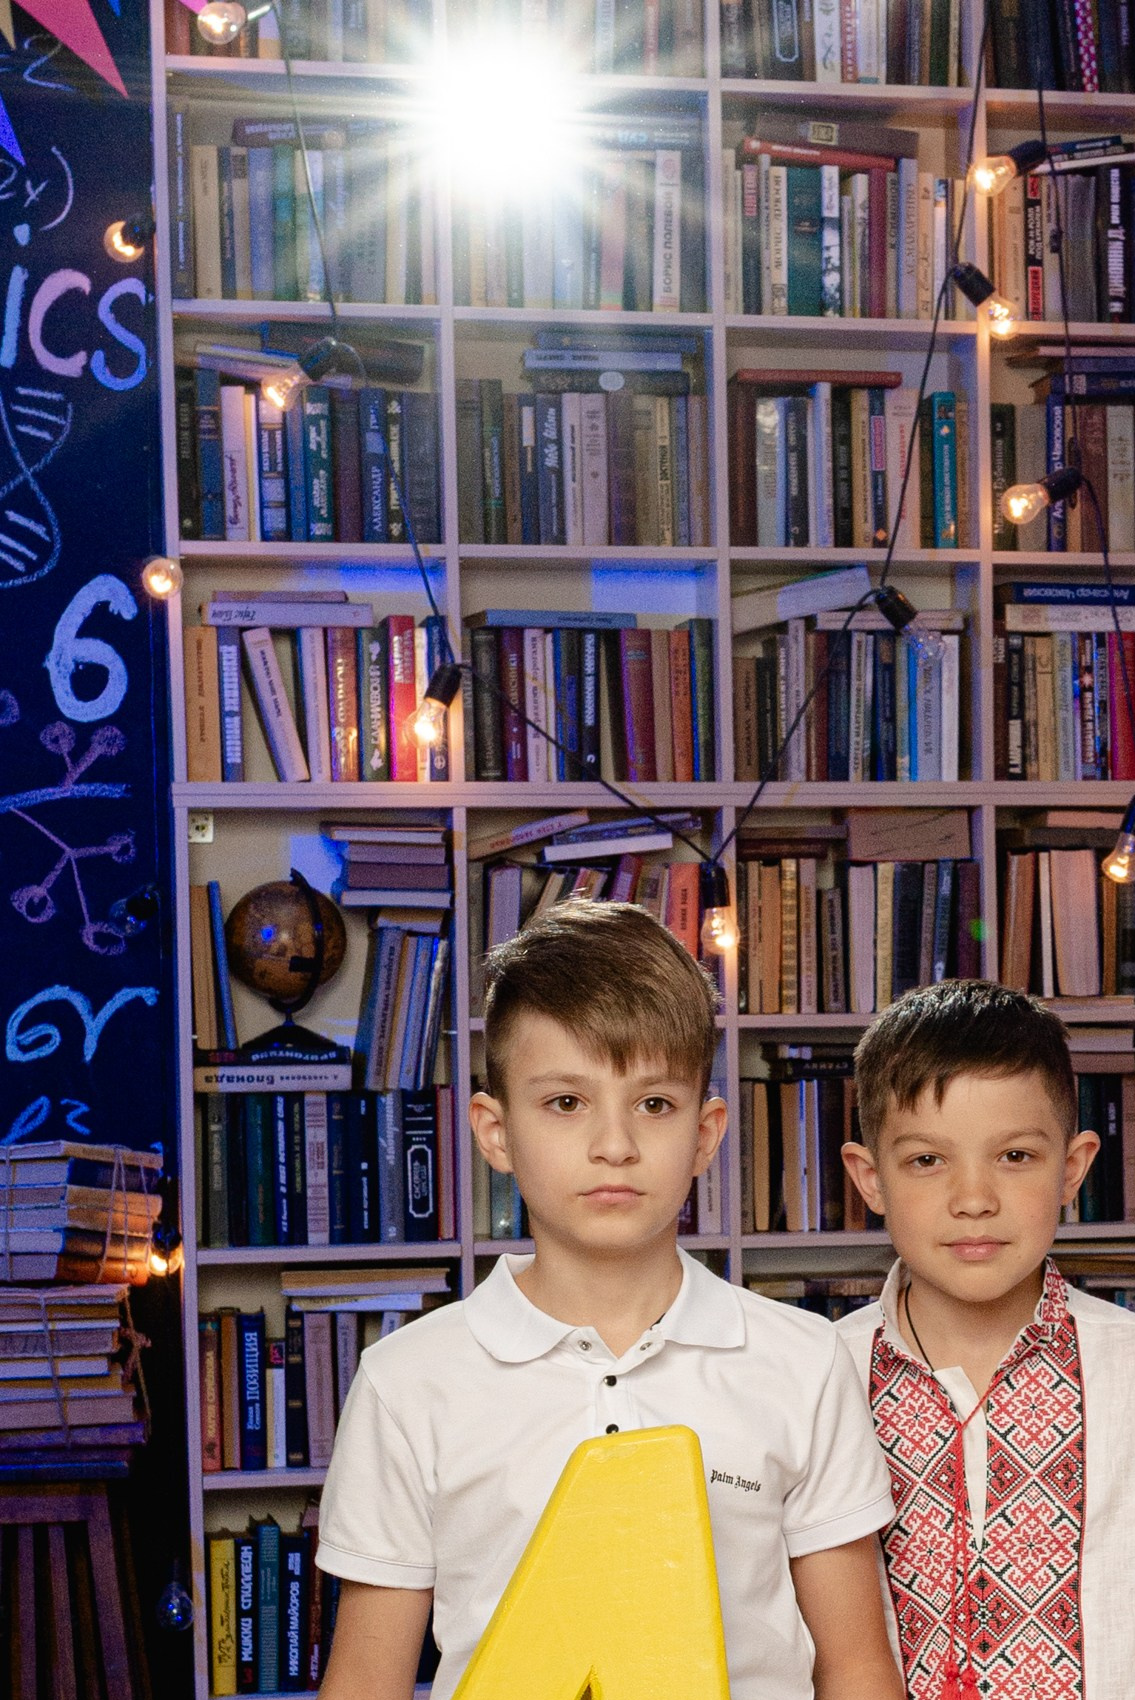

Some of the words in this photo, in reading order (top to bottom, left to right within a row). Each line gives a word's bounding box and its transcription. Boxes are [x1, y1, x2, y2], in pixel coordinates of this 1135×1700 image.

[661, 190, 673, 250] ПОЛЕВОЙ
[662, 253, 673, 294] БОРИС
[1108, 239, 1125, 297] ДЖОННИ
[371, 464, 383, 532] АЛЕКСАНДР
[244, 1331, 259, 1400] ПОЗИЦИЯ
[710, 1469, 734, 1484] Palm
[734, 1474, 761, 1492] Angels
[286, 1580, 299, 1630] МАЙОРОВ
[240, 1617, 253, 1661] МИККИ
[287, 1631, 300, 1676] НИКОЛАЙ
